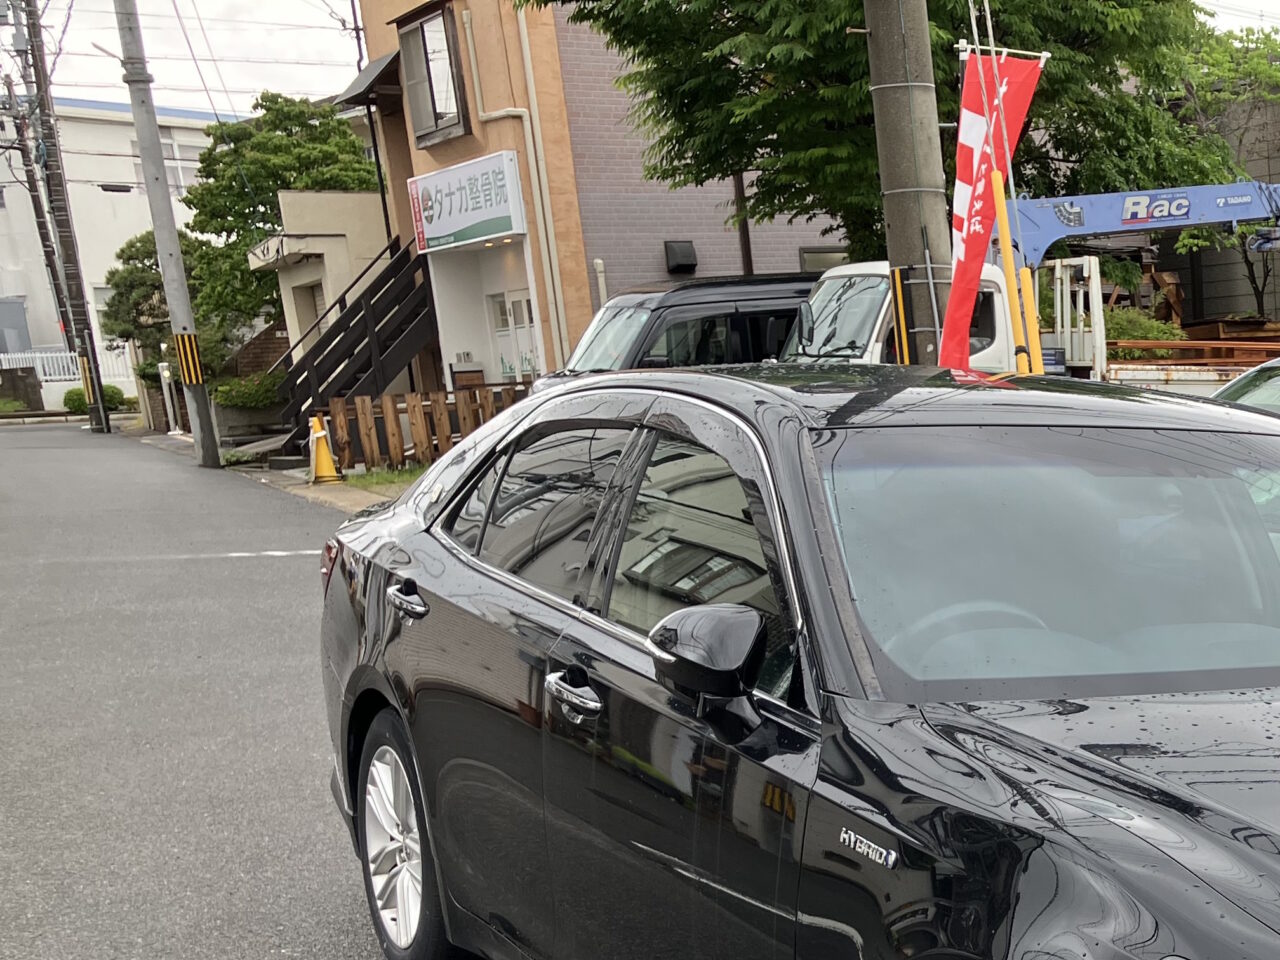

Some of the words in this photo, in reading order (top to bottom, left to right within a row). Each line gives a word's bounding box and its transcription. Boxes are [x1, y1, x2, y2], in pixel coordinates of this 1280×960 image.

[434, 166, 508, 220] タナカ整骨院
[1122, 195, 1190, 219] Rac
[840, 826, 888, 866] HYBRID
